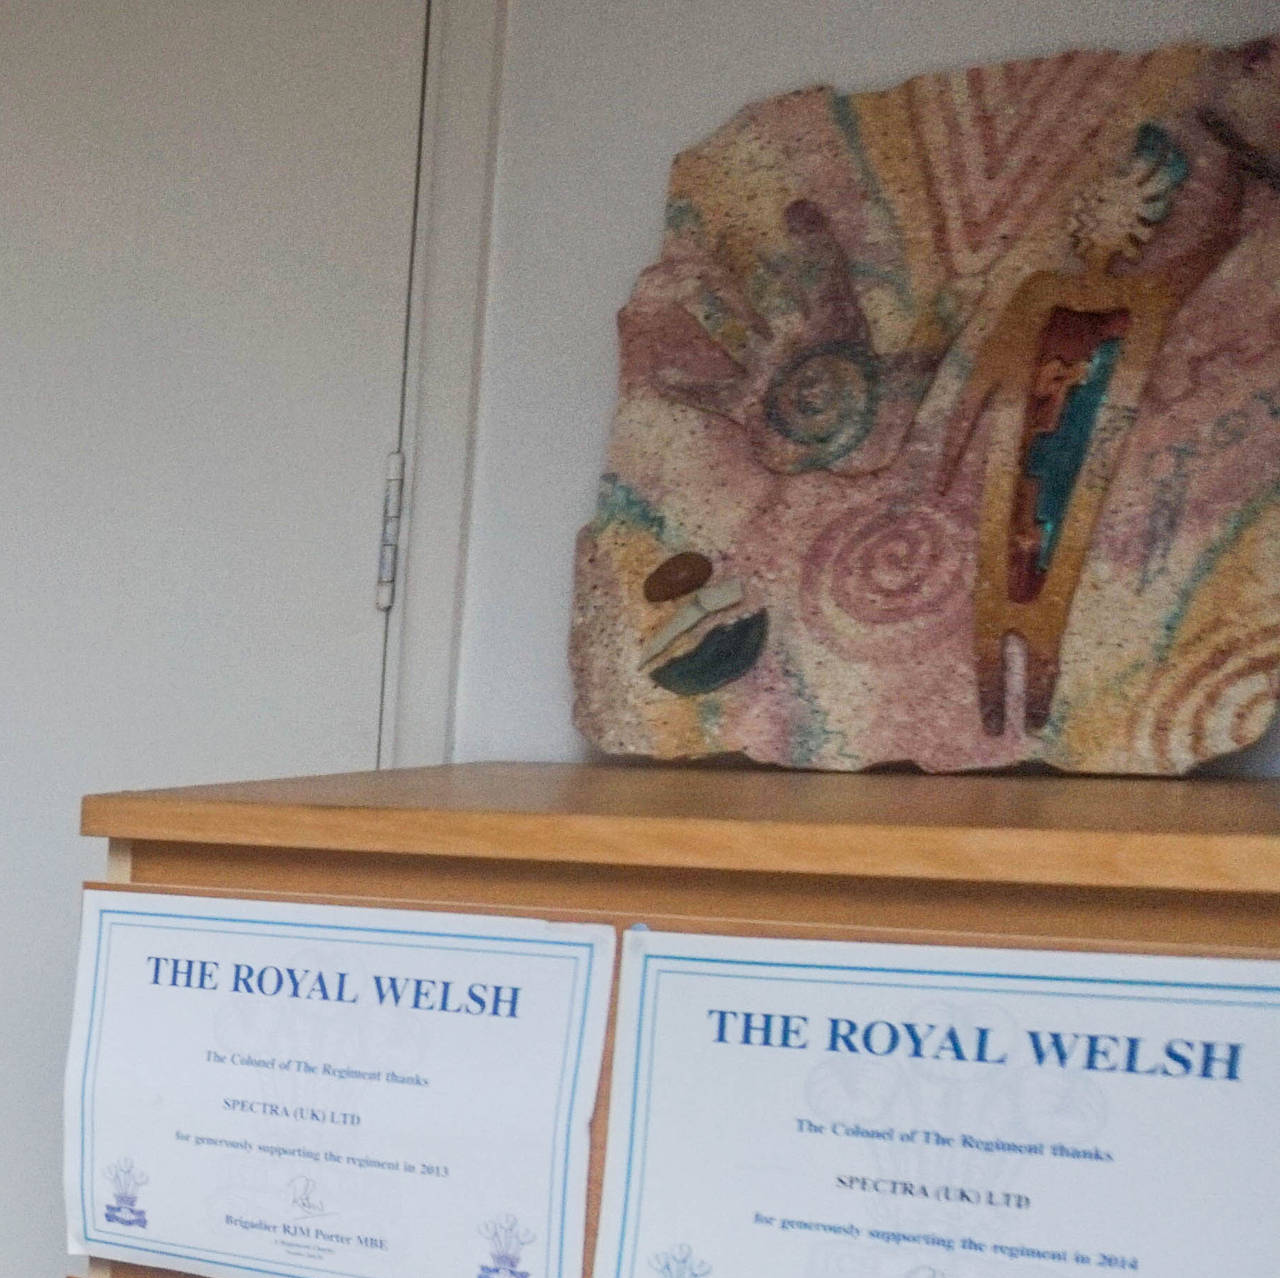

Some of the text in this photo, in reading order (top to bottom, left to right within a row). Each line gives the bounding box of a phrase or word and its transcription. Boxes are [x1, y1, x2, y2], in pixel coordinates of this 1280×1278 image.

[147, 955, 522, 1019] THE ROYAL WELSH
[707, 1009, 1244, 1082] THE ROYAL WELSH
[205, 1051, 429, 1087] The Colonel of The Regiment thanks
[222, 1098, 360, 1126] SPECTRA (UK) LTD
[176, 1131, 449, 1177] for generously supporting the regiment in 2013
[796, 1118, 1114, 1163] The Colonel of The Regiment thanks
[836, 1174, 1030, 1209] SPECTRA (UK) LTD
[225, 1215, 278, 1235] Brigadier
[314, 1228, 352, 1247] Porter
[754, 1212, 1139, 1271] for generously supporting the regiment in 2014
